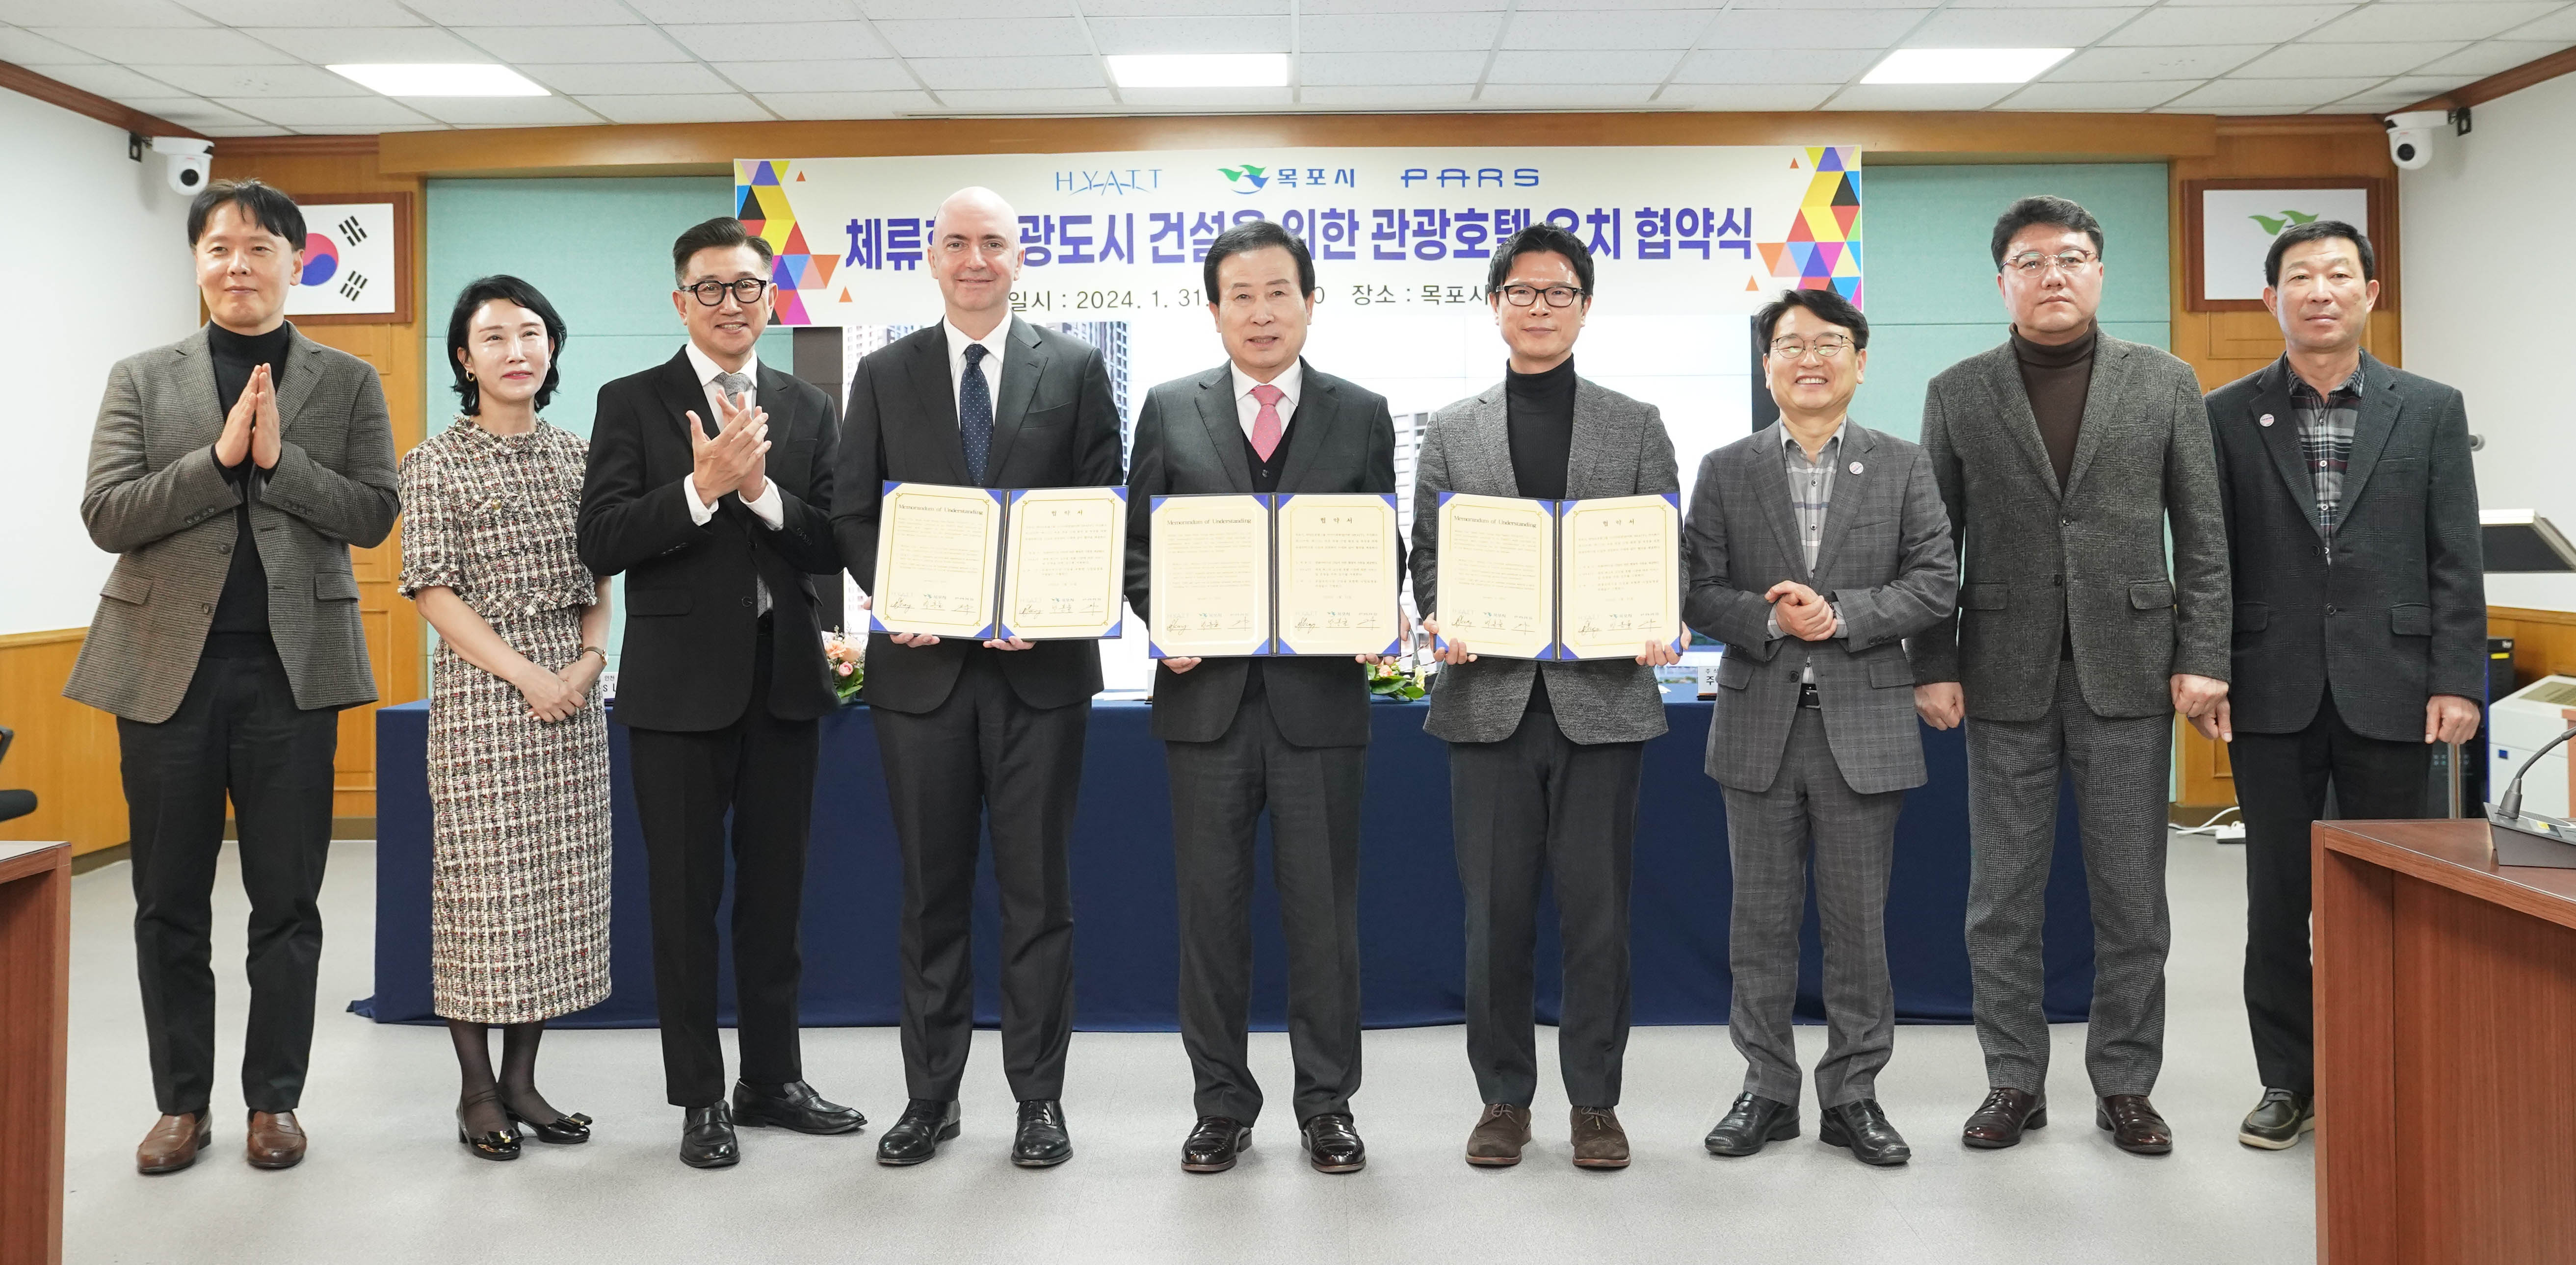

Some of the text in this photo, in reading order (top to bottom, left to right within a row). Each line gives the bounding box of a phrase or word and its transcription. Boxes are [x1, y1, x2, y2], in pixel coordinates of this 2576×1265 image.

[1056, 170, 1162, 196] HYATT
[1278, 168, 1355, 188] 목포시
[1400, 168, 1539, 188] PARS
[845, 217, 935, 271] 체류
[1018, 212, 1134, 267] 광도시
[1634, 207, 1752, 260] 협약식
[1008, 290, 1050, 312] 일시
[1077, 290, 1141, 309] 2024.
[1152, 290, 1167, 308] 1.
[1352, 284, 1396, 305] 장소
